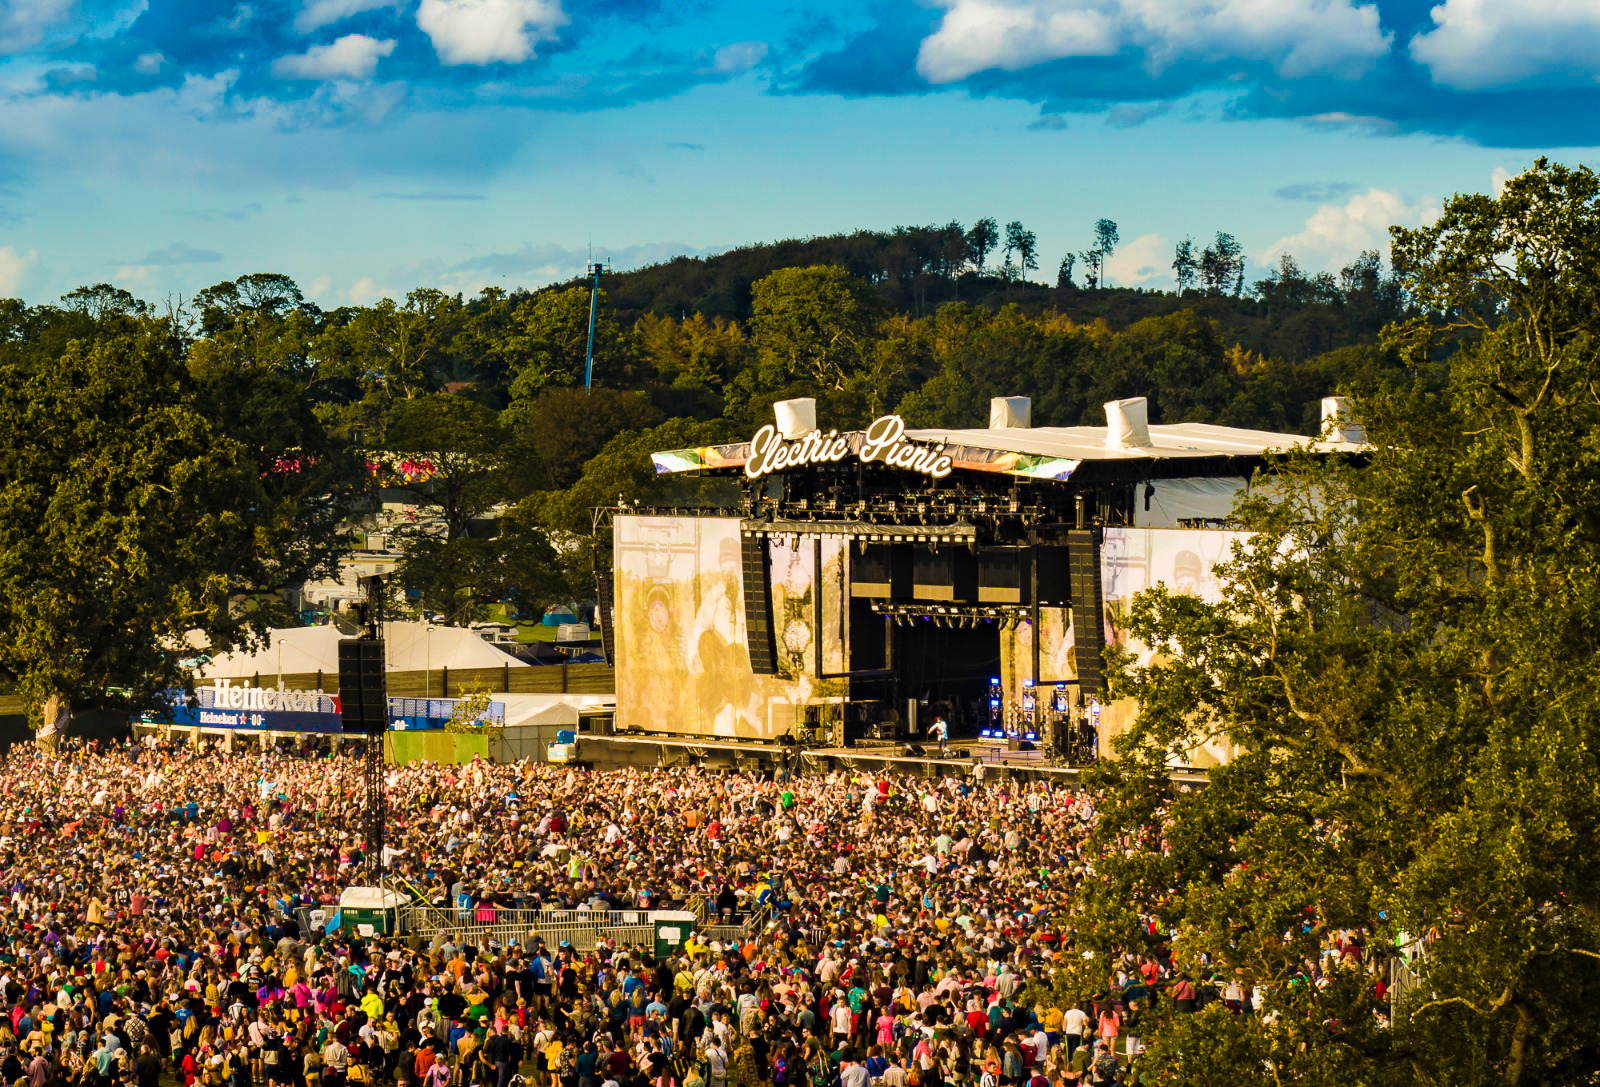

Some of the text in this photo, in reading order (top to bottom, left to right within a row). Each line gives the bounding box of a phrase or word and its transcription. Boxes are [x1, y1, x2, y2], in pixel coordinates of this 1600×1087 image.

[744, 415, 952, 479] Electric Picnic
[213, 678, 321, 712] Heineken
[200, 711, 238, 725] Heineken
